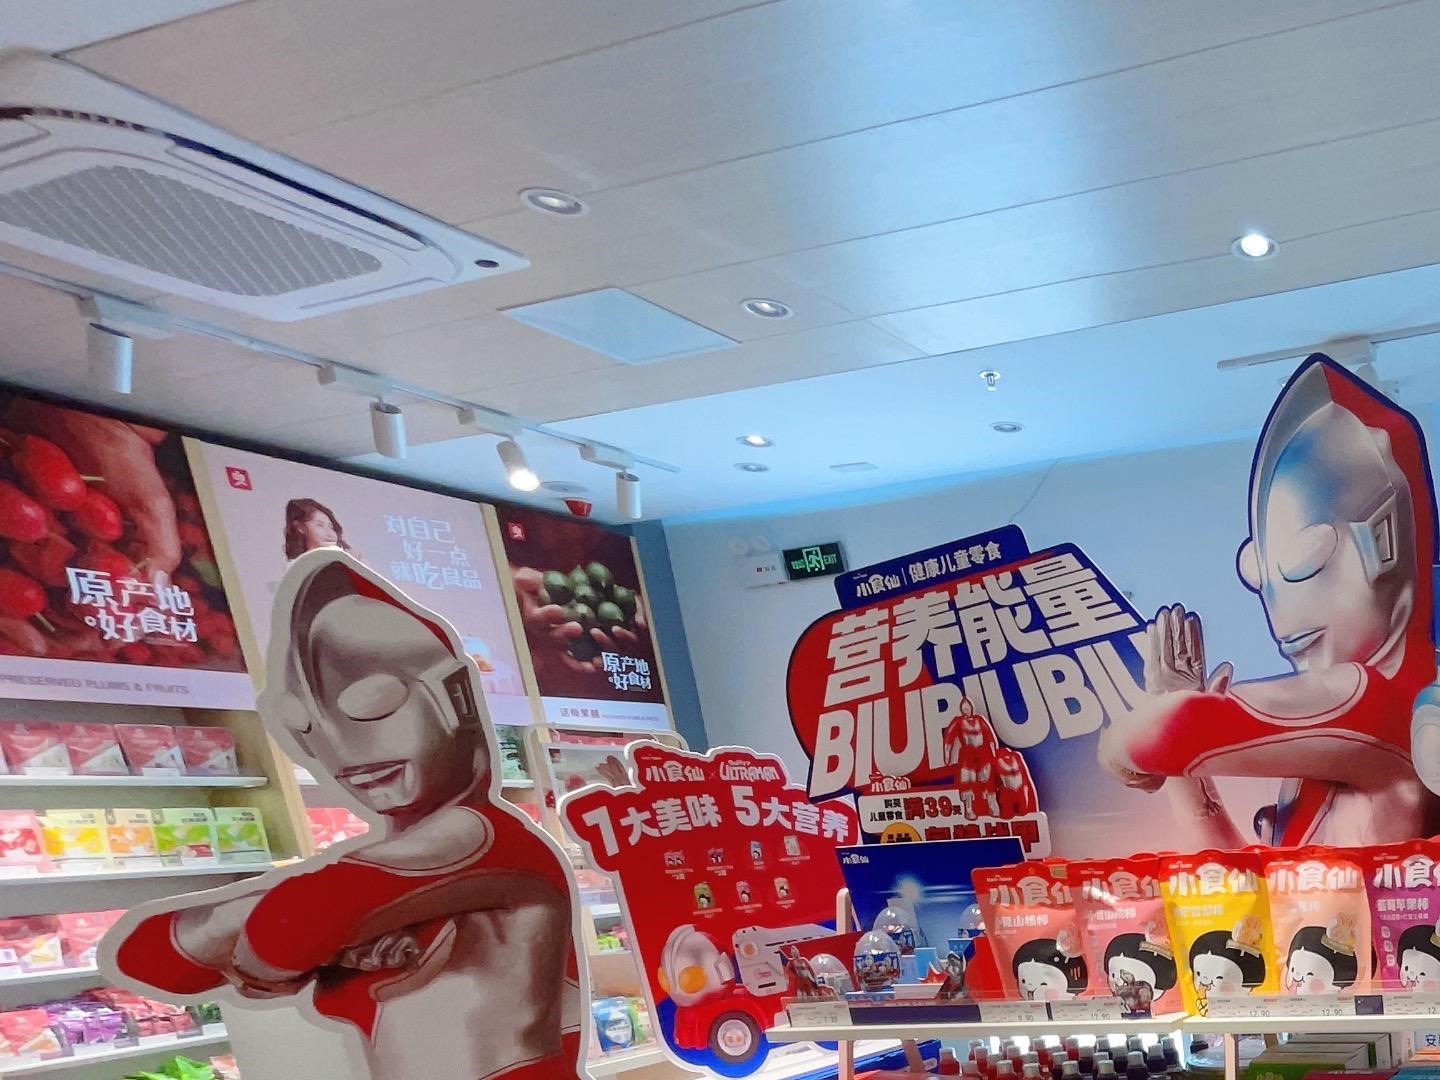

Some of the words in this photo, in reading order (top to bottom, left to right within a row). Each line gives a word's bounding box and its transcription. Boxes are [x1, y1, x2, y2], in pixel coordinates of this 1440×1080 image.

[384, 515, 456, 544] 对自己
[403, 540, 471, 568] 好一点
[824, 553, 837, 564] EXIT
[856, 574, 901, 597] 小食仙
[908, 541, 1002, 583] 健康儿童零食
[391, 560, 482, 590] 就吃良品
[65, 567, 195, 616] 原产地
[98, 607, 198, 643] 好食材
[824, 553, 1139, 707] 营养能量
[601, 652, 650, 676] 原产地
[645, 760, 704, 782] 小食仙
[719, 762, 779, 782] ULTRAMAN
[583, 794, 722, 857] 1大美味
[731, 785, 849, 842] 5大营养
[1168, 862, 1257, 896] 小食仙
[1269, 860, 1357, 891] 小食仙
[989, 876, 1073, 906] 小食仙
